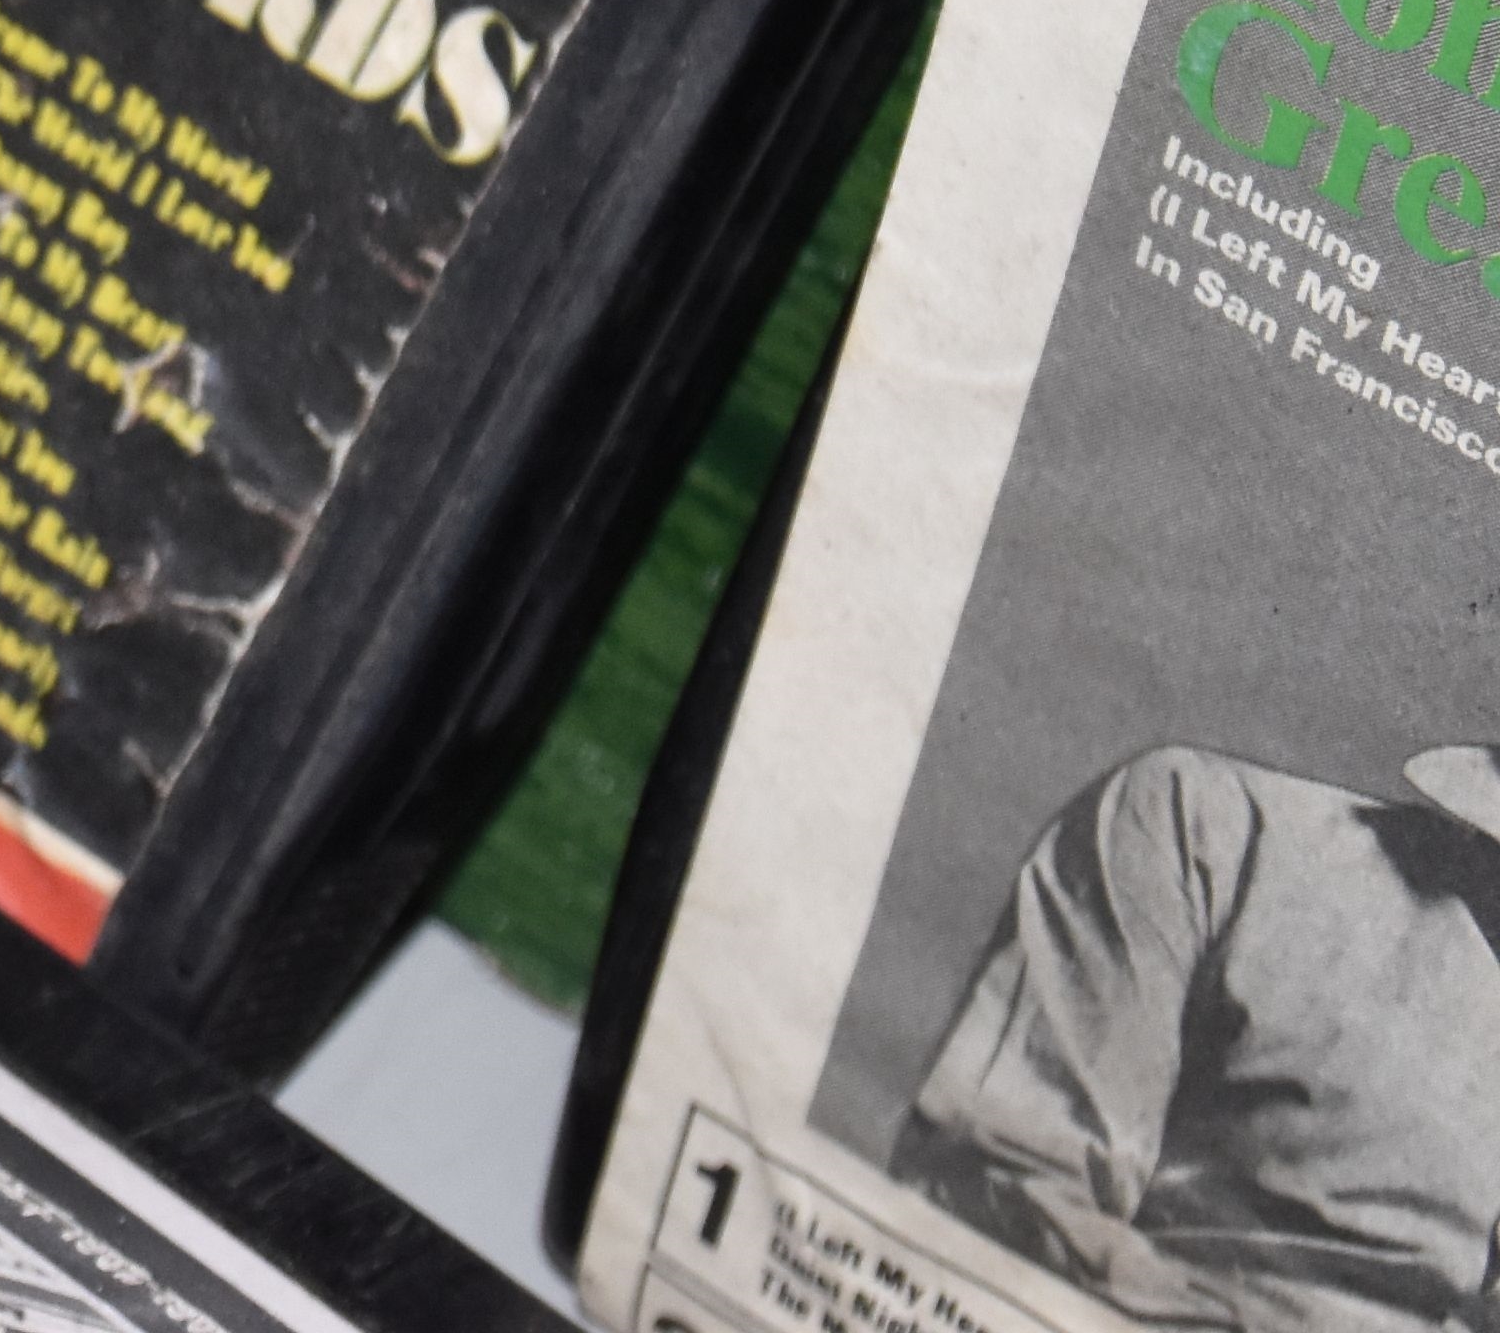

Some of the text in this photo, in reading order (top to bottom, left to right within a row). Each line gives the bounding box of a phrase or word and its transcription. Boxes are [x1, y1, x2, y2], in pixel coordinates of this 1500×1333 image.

[170, 123, 268, 206] World
[1174, 0, 1500, 301] Gre
[1162, 134, 1382, 293] Including
[1133, 234, 1181, 288] In
[1192, 269, 1280, 350] San
[1150, 185, 1500, 415] (I Left My Hear
[696, 1163, 740, 1246] 1
[762, 1267, 809, 1321] The
[876, 1256, 923, 1306] My
[934, 1292, 989, 1333] He
